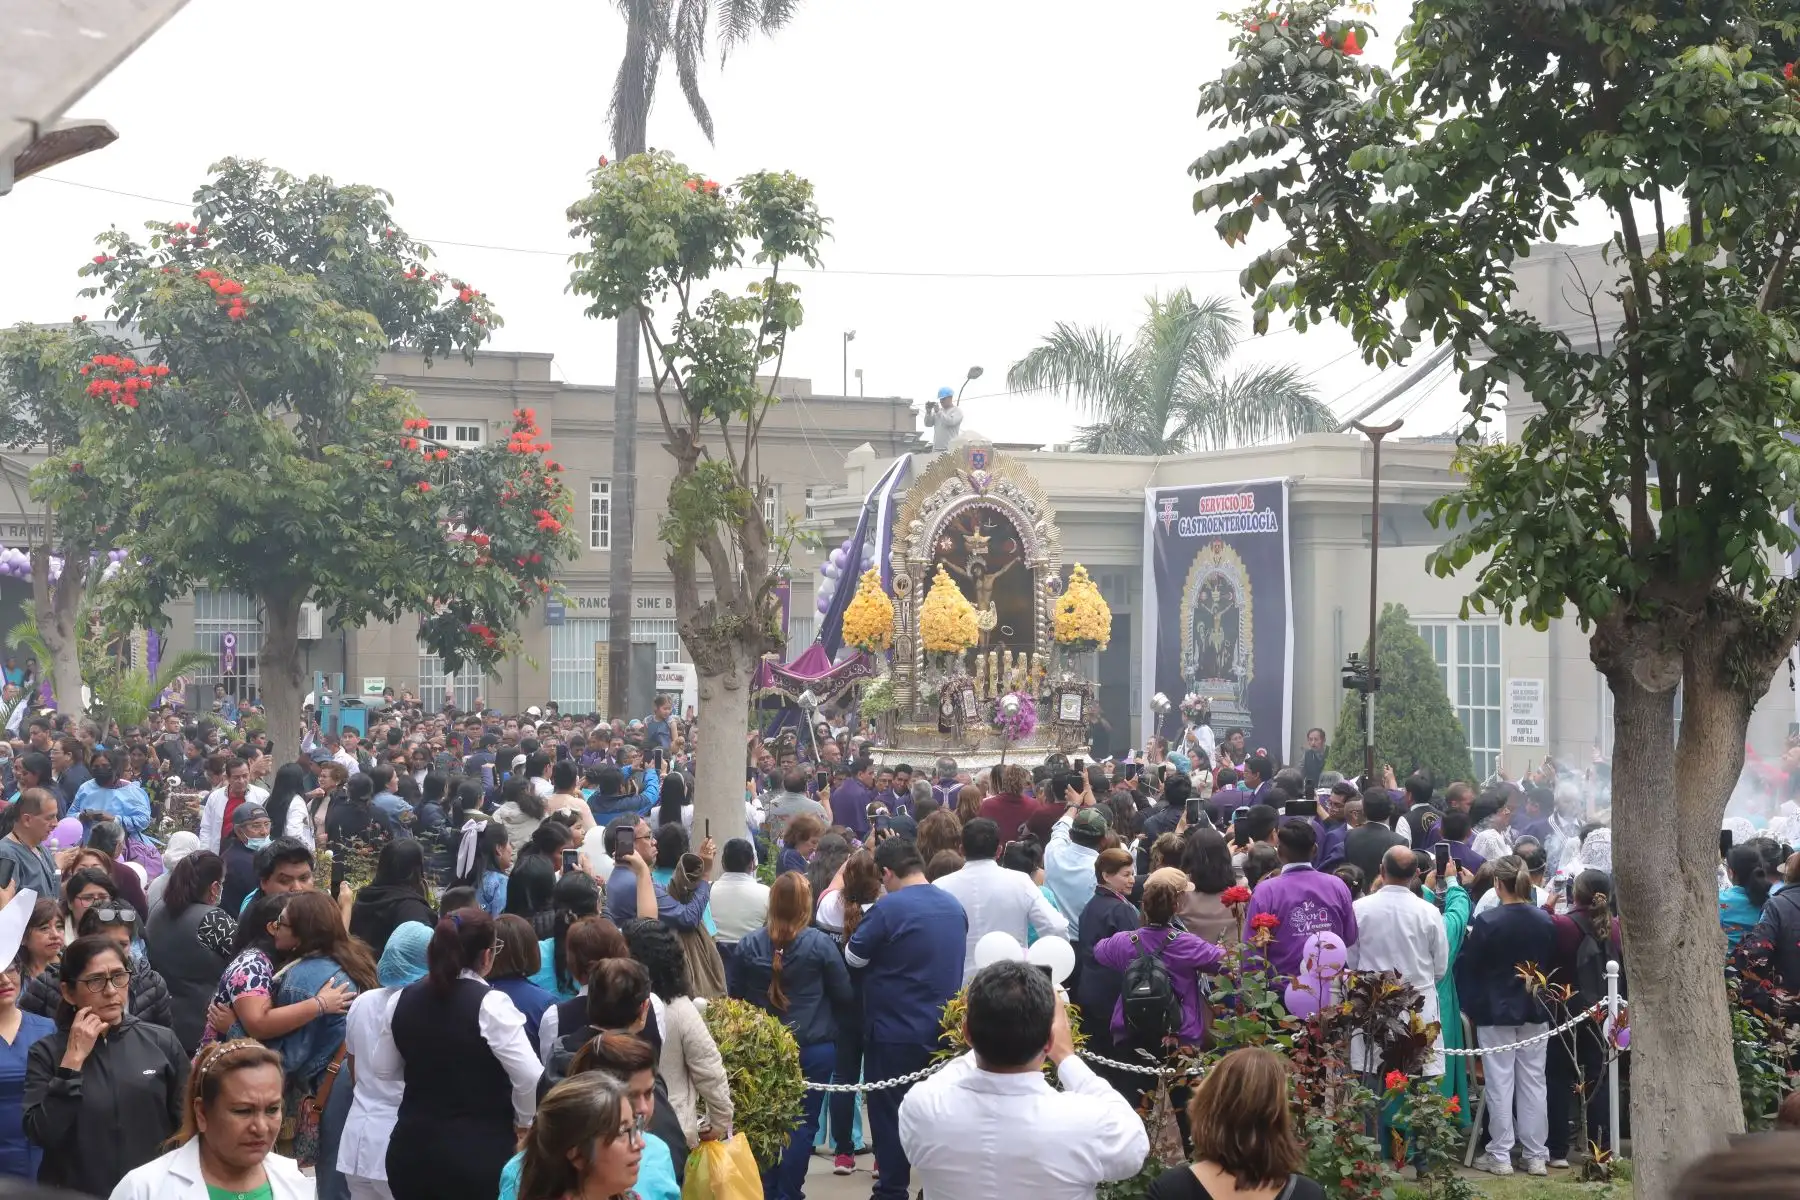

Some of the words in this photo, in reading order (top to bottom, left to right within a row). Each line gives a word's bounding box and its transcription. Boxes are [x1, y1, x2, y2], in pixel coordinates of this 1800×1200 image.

[1200, 494, 1240, 513] SERVICIO
[1241, 493, 1254, 511] DE
[1179, 508, 1277, 535] GASTROENTEROLOGÍA
[637, 598, 661, 608] SINE
